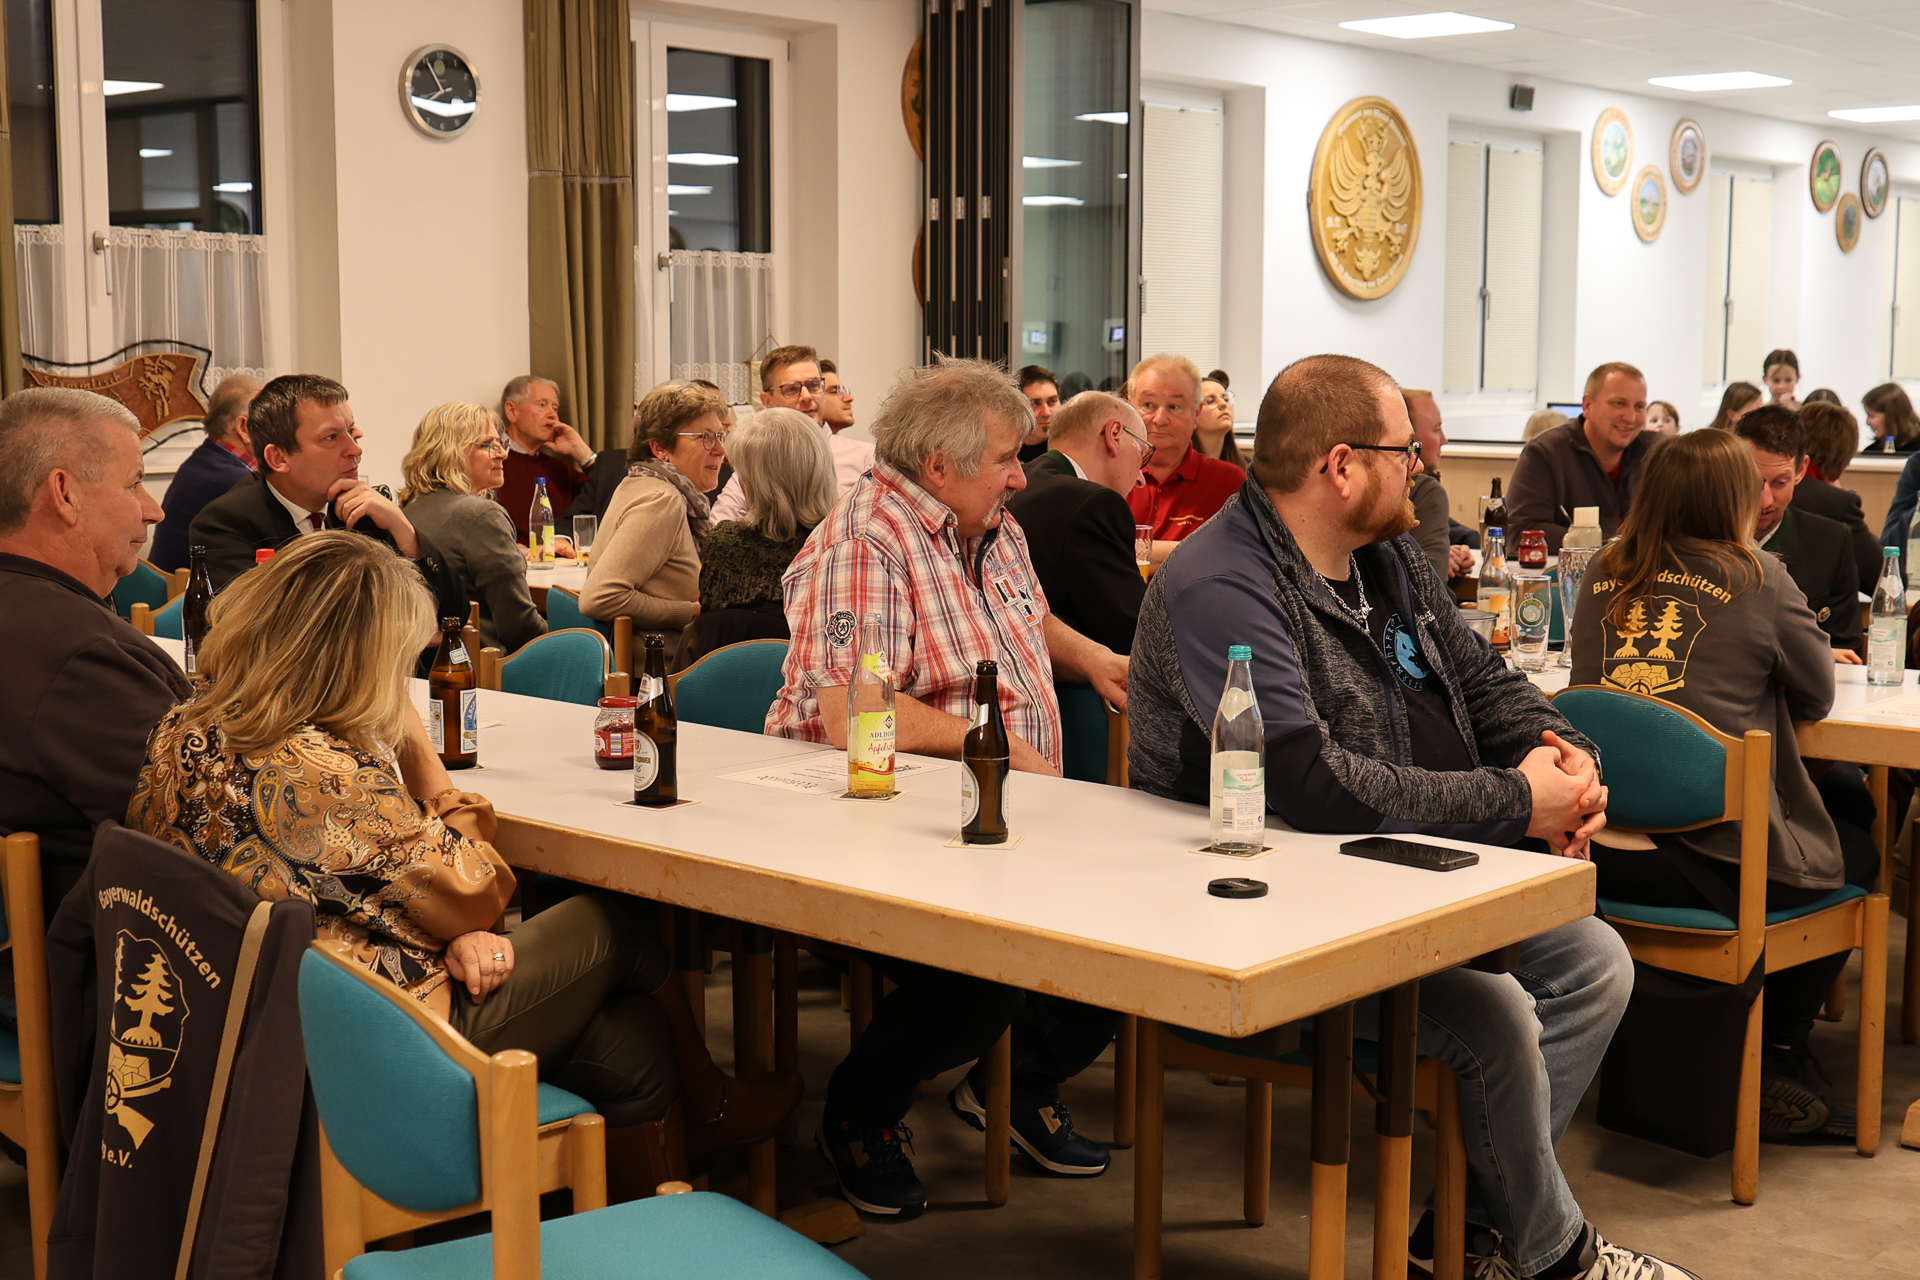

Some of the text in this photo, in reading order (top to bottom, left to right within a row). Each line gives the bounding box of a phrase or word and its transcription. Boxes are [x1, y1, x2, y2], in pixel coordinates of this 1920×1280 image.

[43, 372, 121, 388] Stammtisch
[1593, 570, 1732, 603] Bayedschützen
[98, 886, 222, 989] Bayerwaldschützen
[107, 1149, 133, 1169] e.V.
